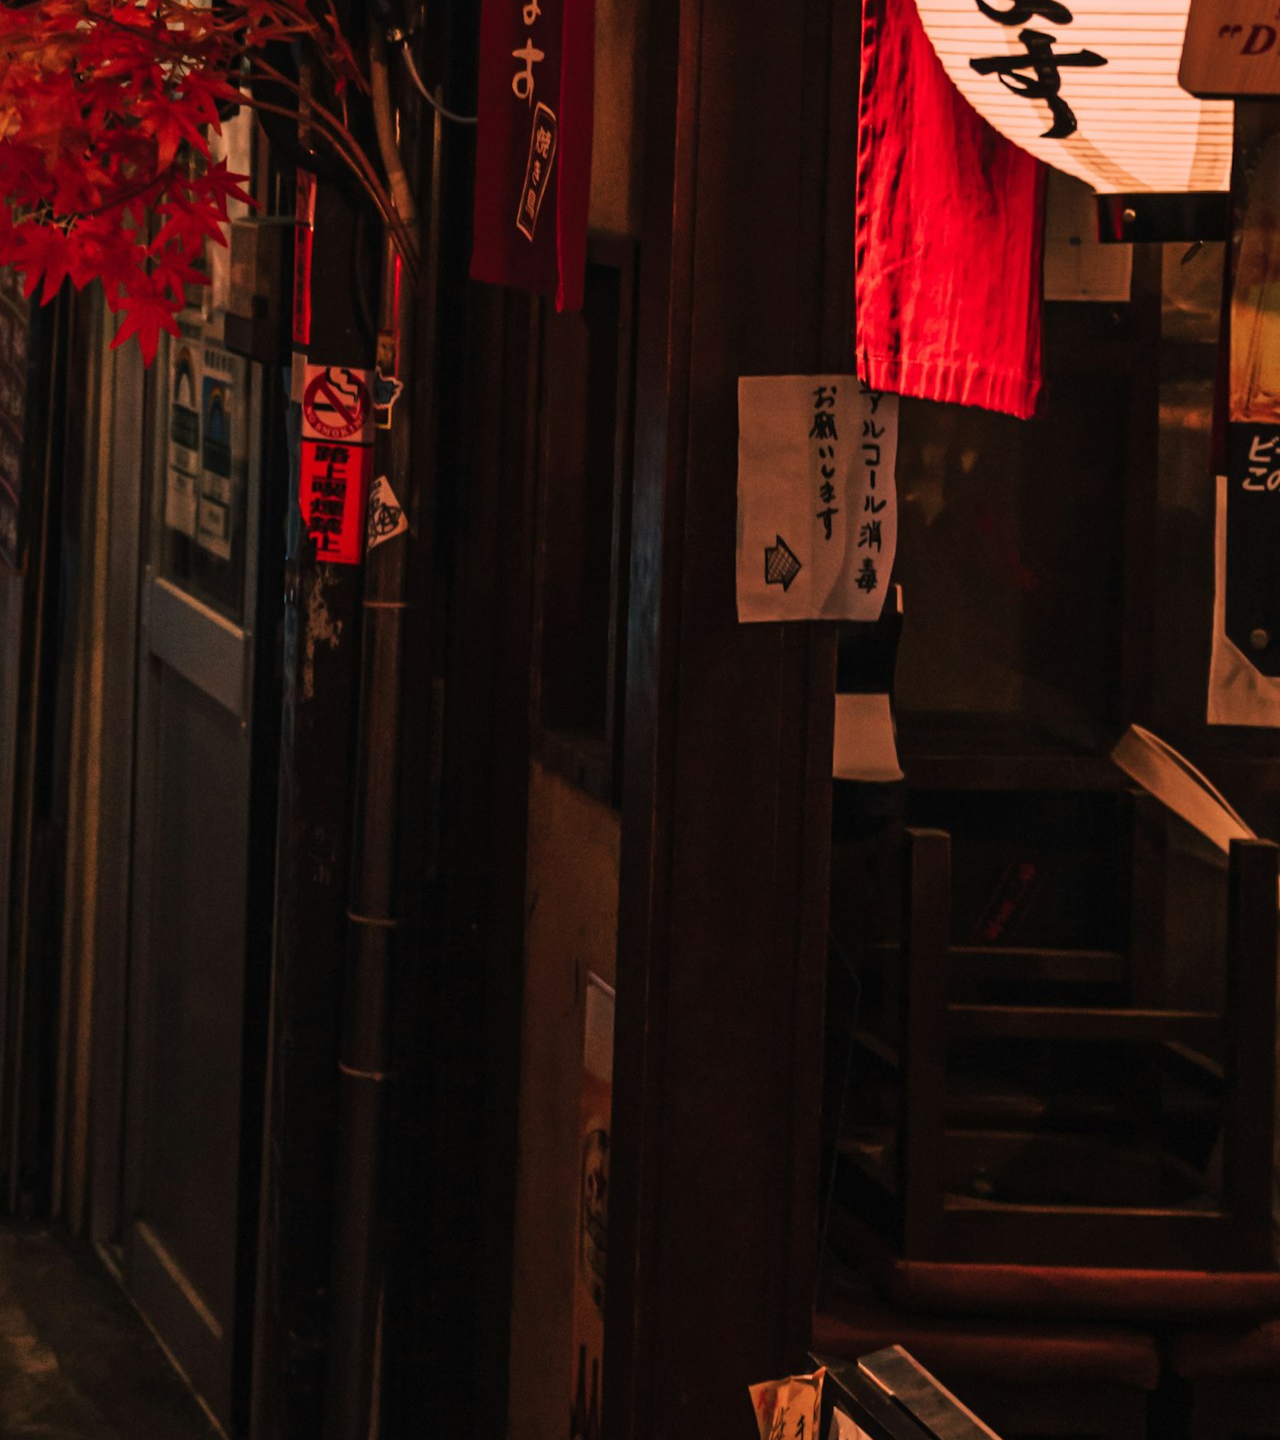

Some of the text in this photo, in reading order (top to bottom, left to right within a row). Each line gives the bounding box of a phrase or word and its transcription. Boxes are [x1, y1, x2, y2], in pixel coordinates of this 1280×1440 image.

[808, 385, 839, 540] お願いします
